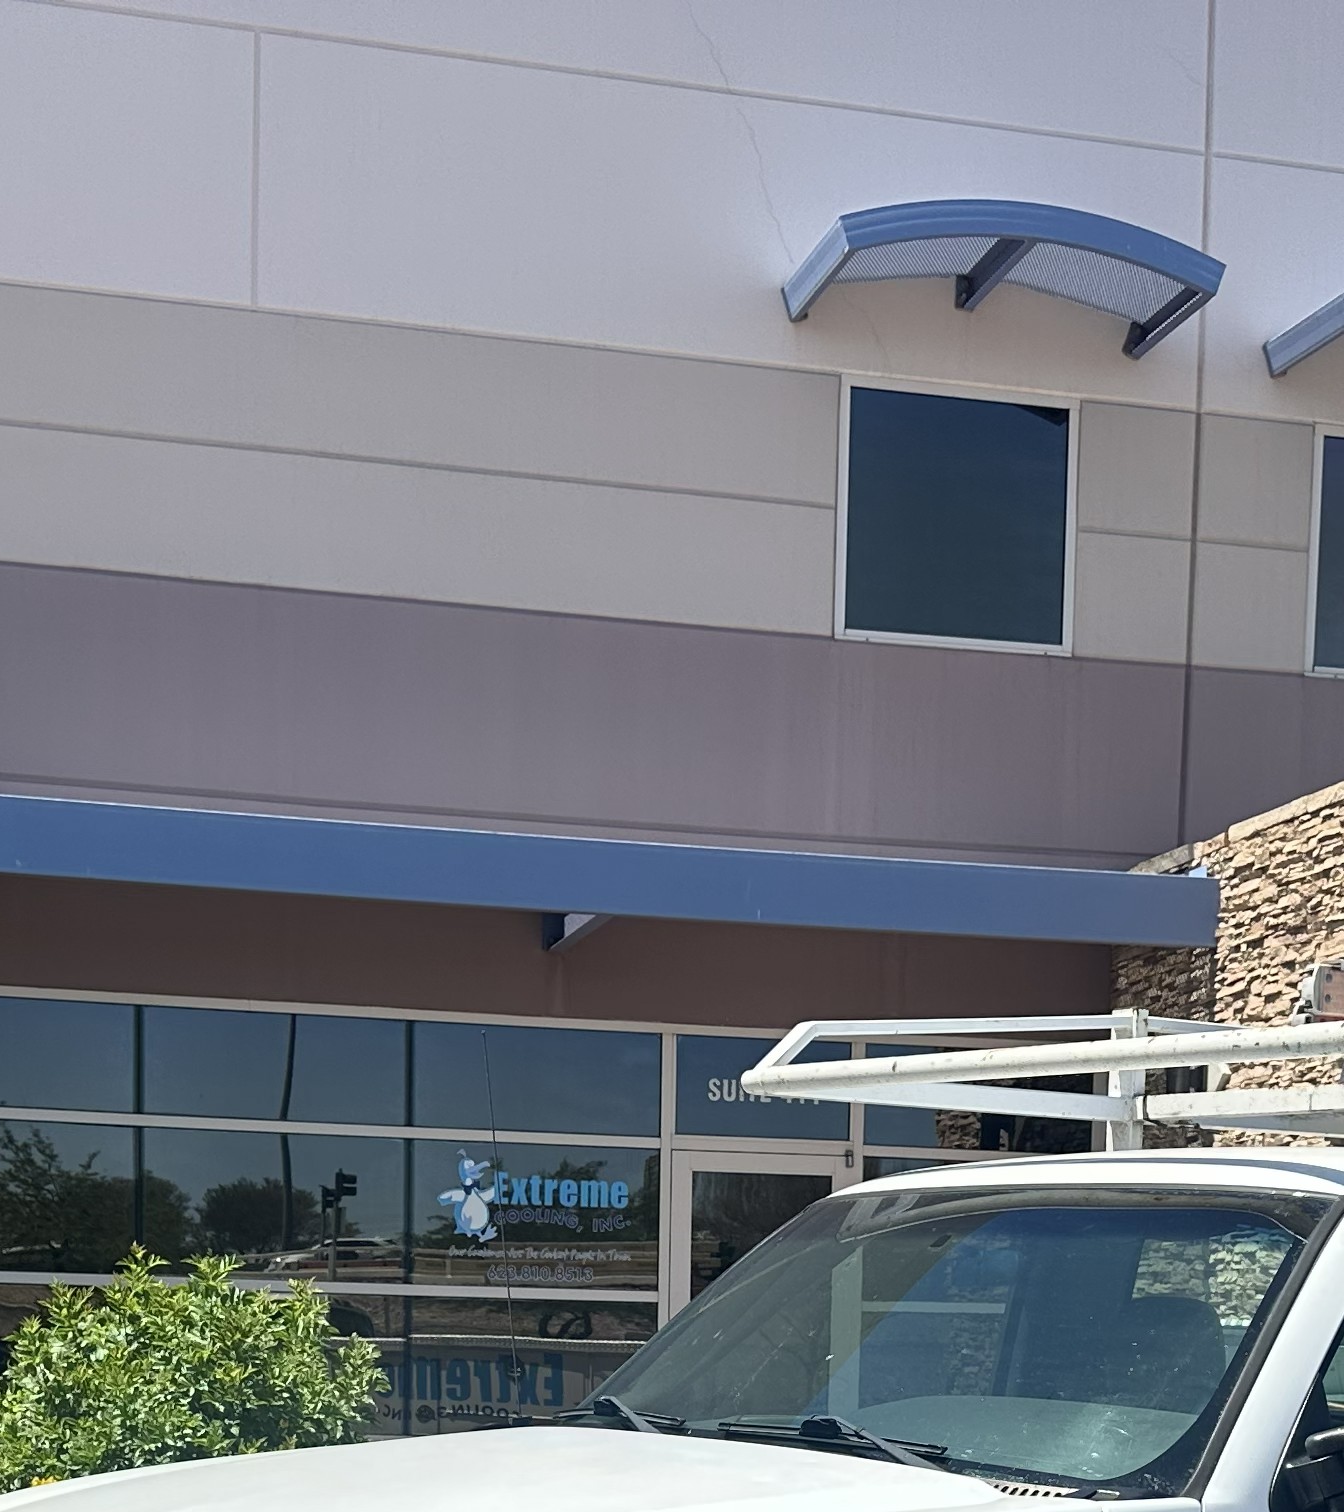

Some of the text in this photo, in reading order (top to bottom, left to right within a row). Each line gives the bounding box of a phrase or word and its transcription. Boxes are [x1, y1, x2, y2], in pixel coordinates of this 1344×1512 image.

[493, 1170, 629, 1209] Extreme
[493, 1208, 632, 1234] COOLING, INC.
[487, 1264, 594, 1283] 623.810.8513
